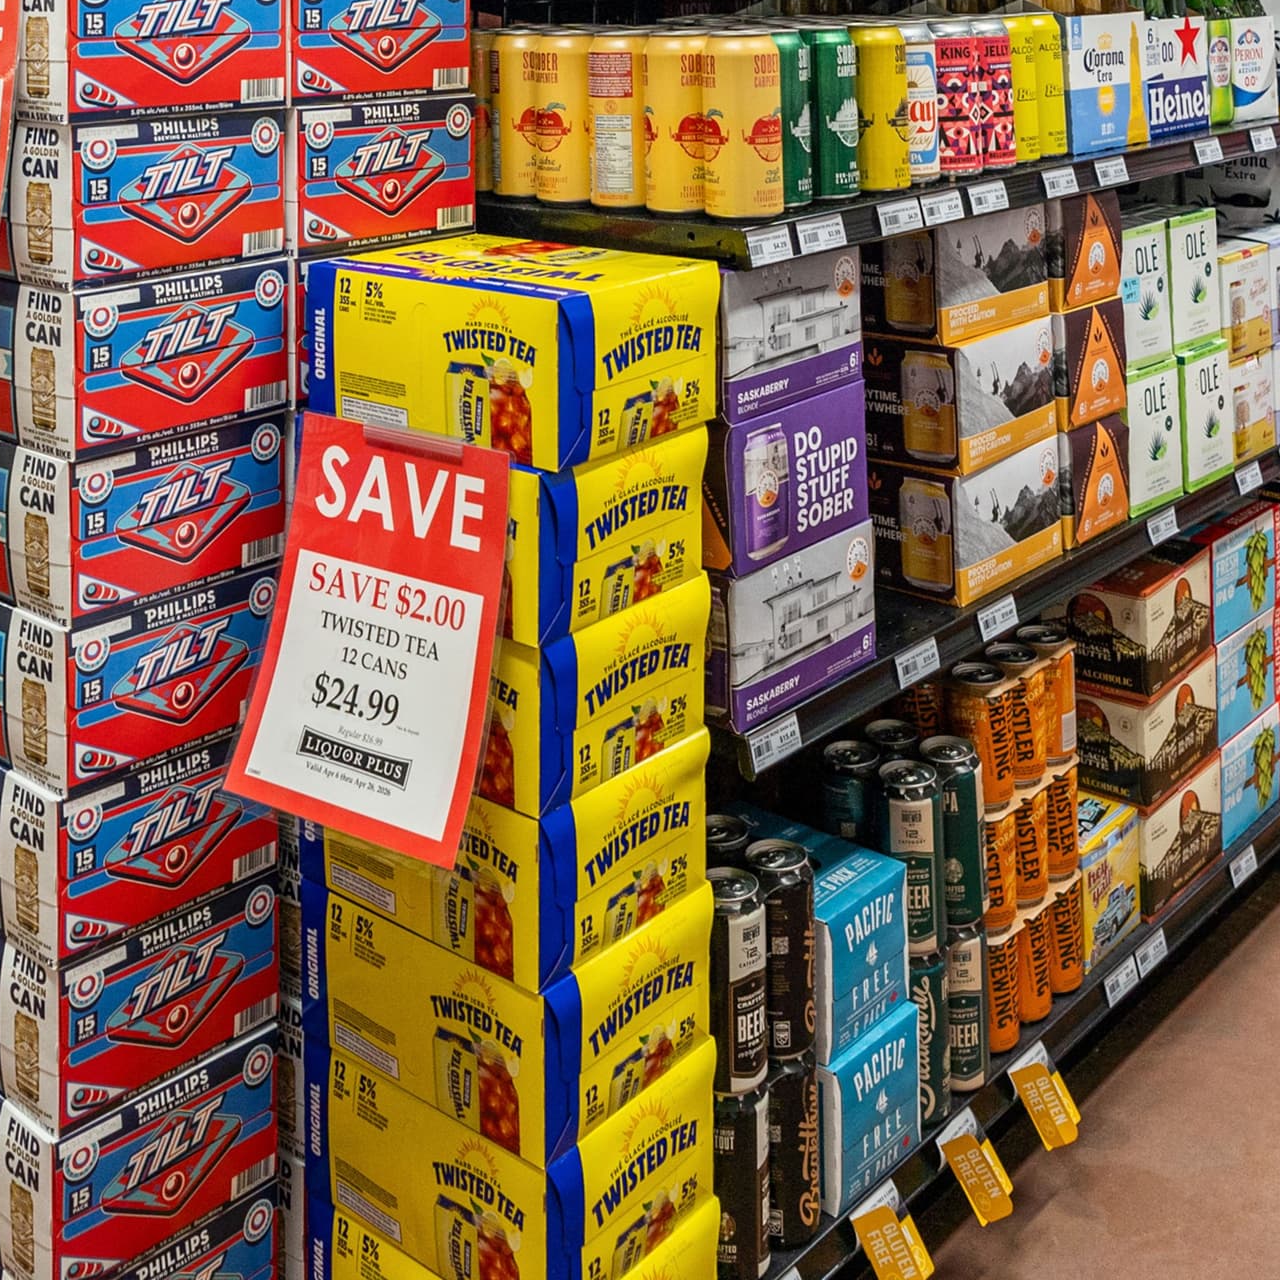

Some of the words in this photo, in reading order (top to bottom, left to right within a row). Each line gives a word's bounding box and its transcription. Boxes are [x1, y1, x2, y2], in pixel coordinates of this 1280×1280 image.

[940, 43, 971, 59] KING
[983, 42, 1010, 58] JELLY
[1083, 48, 1124, 73] Corona
[1234, 47, 1264, 61] PERONI
[1097, 70, 1112, 82] Cero
[1135, 237, 1159, 275] OLÉ
[339, 277, 351, 294] 12
[339, 295, 350, 305] 355
[366, 281, 382, 299] 5%
[314, 307, 327, 380] ORIGINAL
[484, 321, 498, 329] ICED
[500, 325, 513, 334] TEA
[620, 328, 632, 340] THÉ
[635, 319, 654, 332] GLACÉ
[656, 314, 689, 325] ALCOOLISÉ
[443, 328, 506, 353] TWISTED
[508, 335, 536, 367] TEA
[602, 326, 674, 381] TWISTED
[676, 324, 702, 352] TEA
[685, 379, 700, 398] 5%
[738, 378, 790, 405] SASKABERRY
[598, 408, 610, 427] 12
[738, 401, 759, 415] BLONDE
[795, 426, 822, 454] DO
[796, 436, 858, 482] STUPID
[315, 444, 487, 553] SAVE
[797, 465, 851, 508] STUFF
[797, 491, 854, 532] SOBER
[309, 562, 390, 611] SAVE
[395, 583, 466, 631] $2.00
[321, 610, 400, 648] TWISTED
[405, 634, 440, 661] TEA
[341, 646, 358, 665] 12
[361, 652, 408, 680] CANS
[312, 671, 399, 726] $24.99
[338, 725, 360, 741] Regular
[989, 696, 1011, 781] BREWING
[305, 735, 364, 767] LIQUOR
[366, 755, 403, 780] PLUS
[306, 760, 321, 773] Valid
[322, 766, 335, 778] Apr
[340, 771, 353, 784] thru
[354, 776, 366, 789] Apr
[377, 783, 391, 797] 2026
[1081, 776, 1130, 798] ALCOHOLIC
[845, 892, 894, 952] PACIFIC
[853, 1038, 906, 1102] PACIFIC
[1022, 1080, 1044, 1115] FREE
[1036, 1076, 1068, 1127] GLUTEN
[862, 1109, 902, 1158] FREE
[864, 1172, 871, 1186] 6
[872, 1147, 898, 1180] PACK
